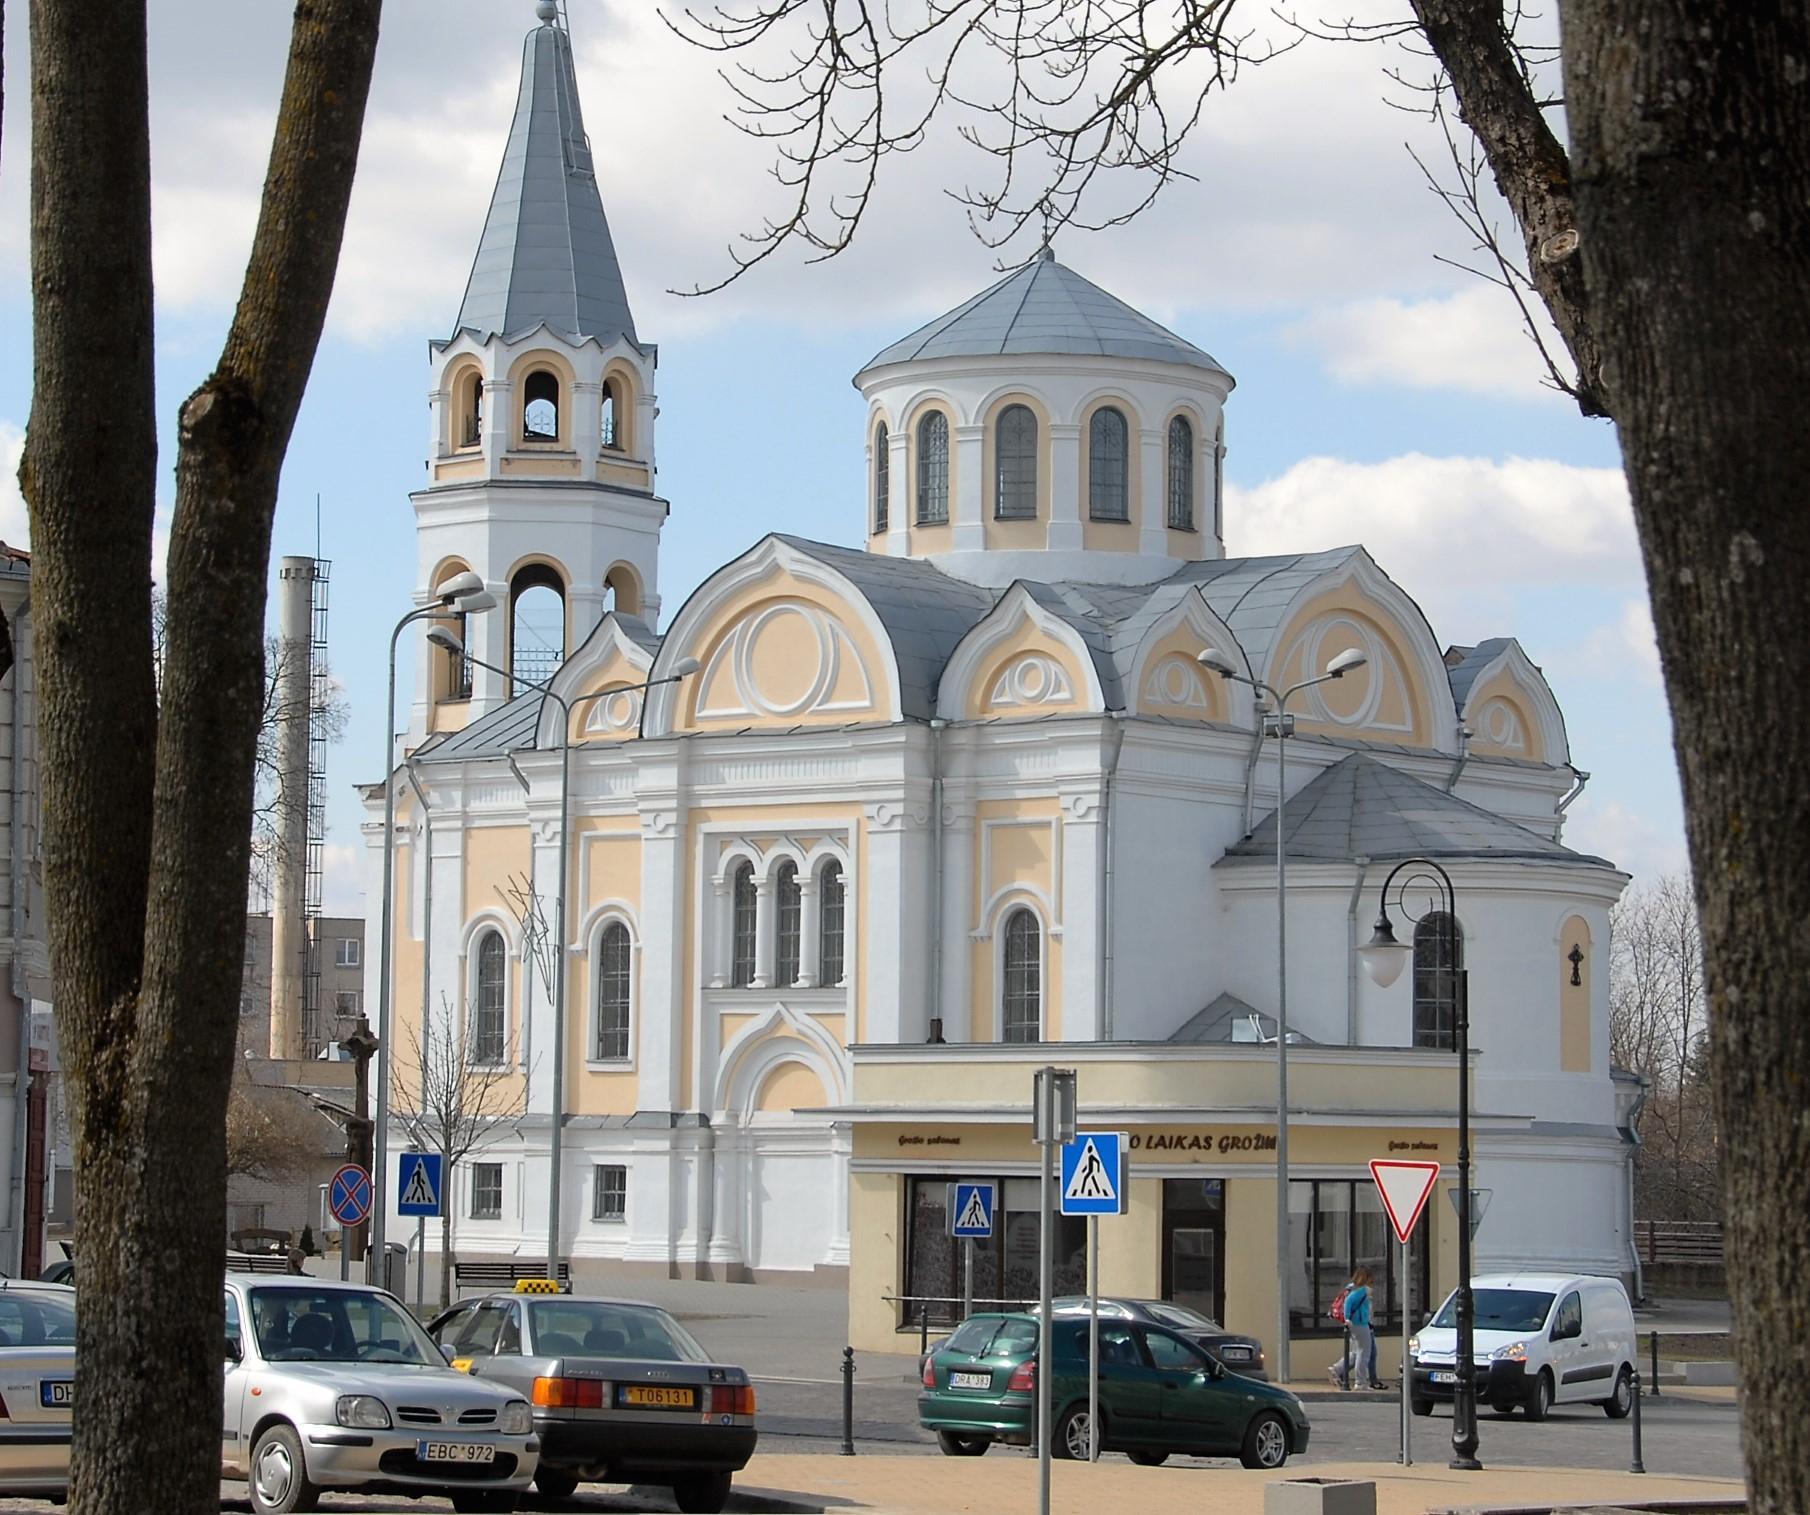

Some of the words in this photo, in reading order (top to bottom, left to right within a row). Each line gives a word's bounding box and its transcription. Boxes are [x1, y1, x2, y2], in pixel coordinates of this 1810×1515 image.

[1145, 1134, 1213, 1150] LAIKAS
[954, 1374, 971, 1385] DRA
[637, 1388, 688, 1404] T06131
[427, 1444, 458, 1460] EBC
[467, 1446, 493, 1461] 972
